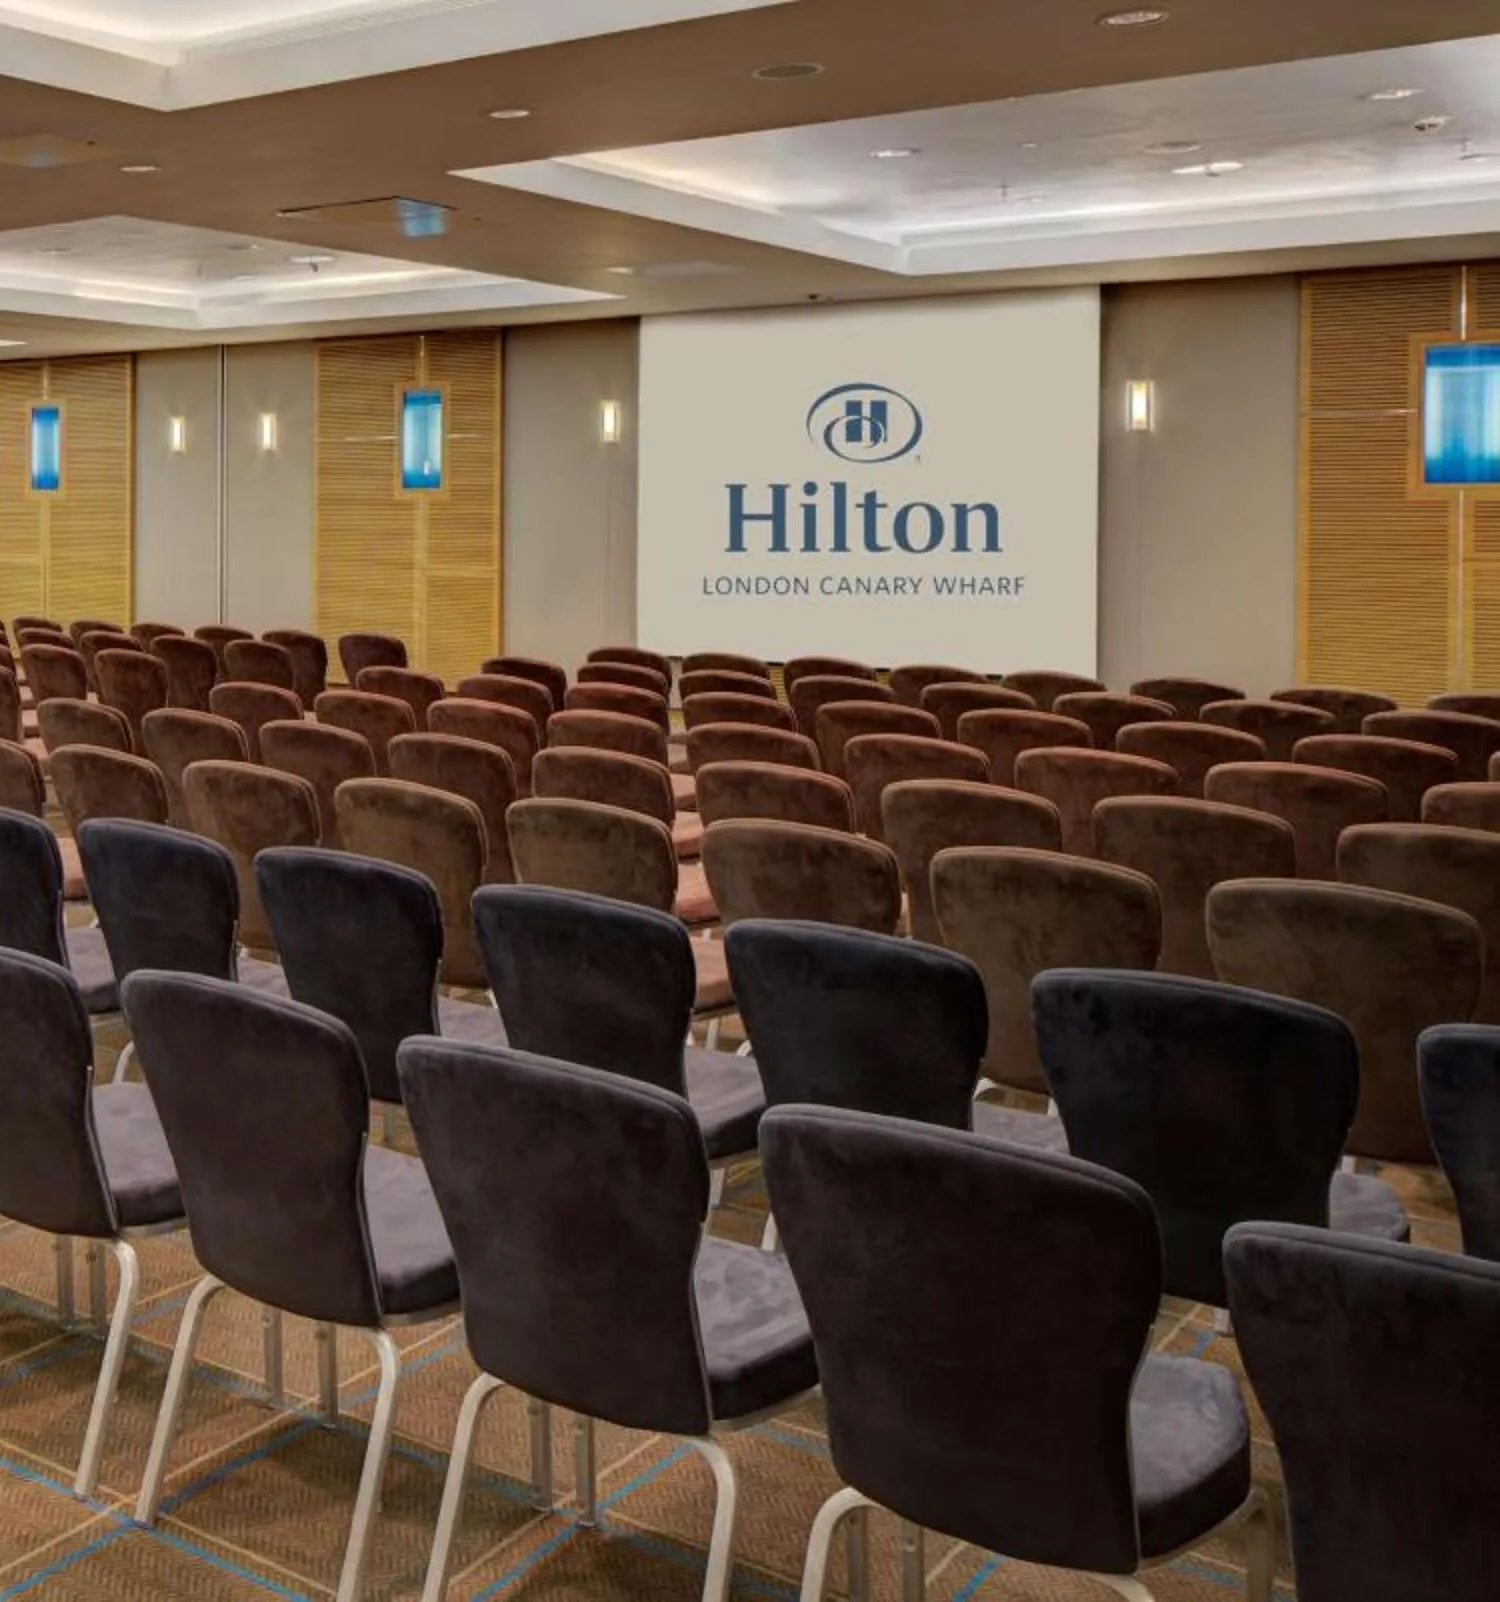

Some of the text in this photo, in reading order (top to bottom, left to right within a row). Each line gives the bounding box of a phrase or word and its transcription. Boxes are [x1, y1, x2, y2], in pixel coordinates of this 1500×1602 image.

[723, 480, 1003, 555] Hilton
[702, 575, 1025, 596] LONDON CANARY WHARF
